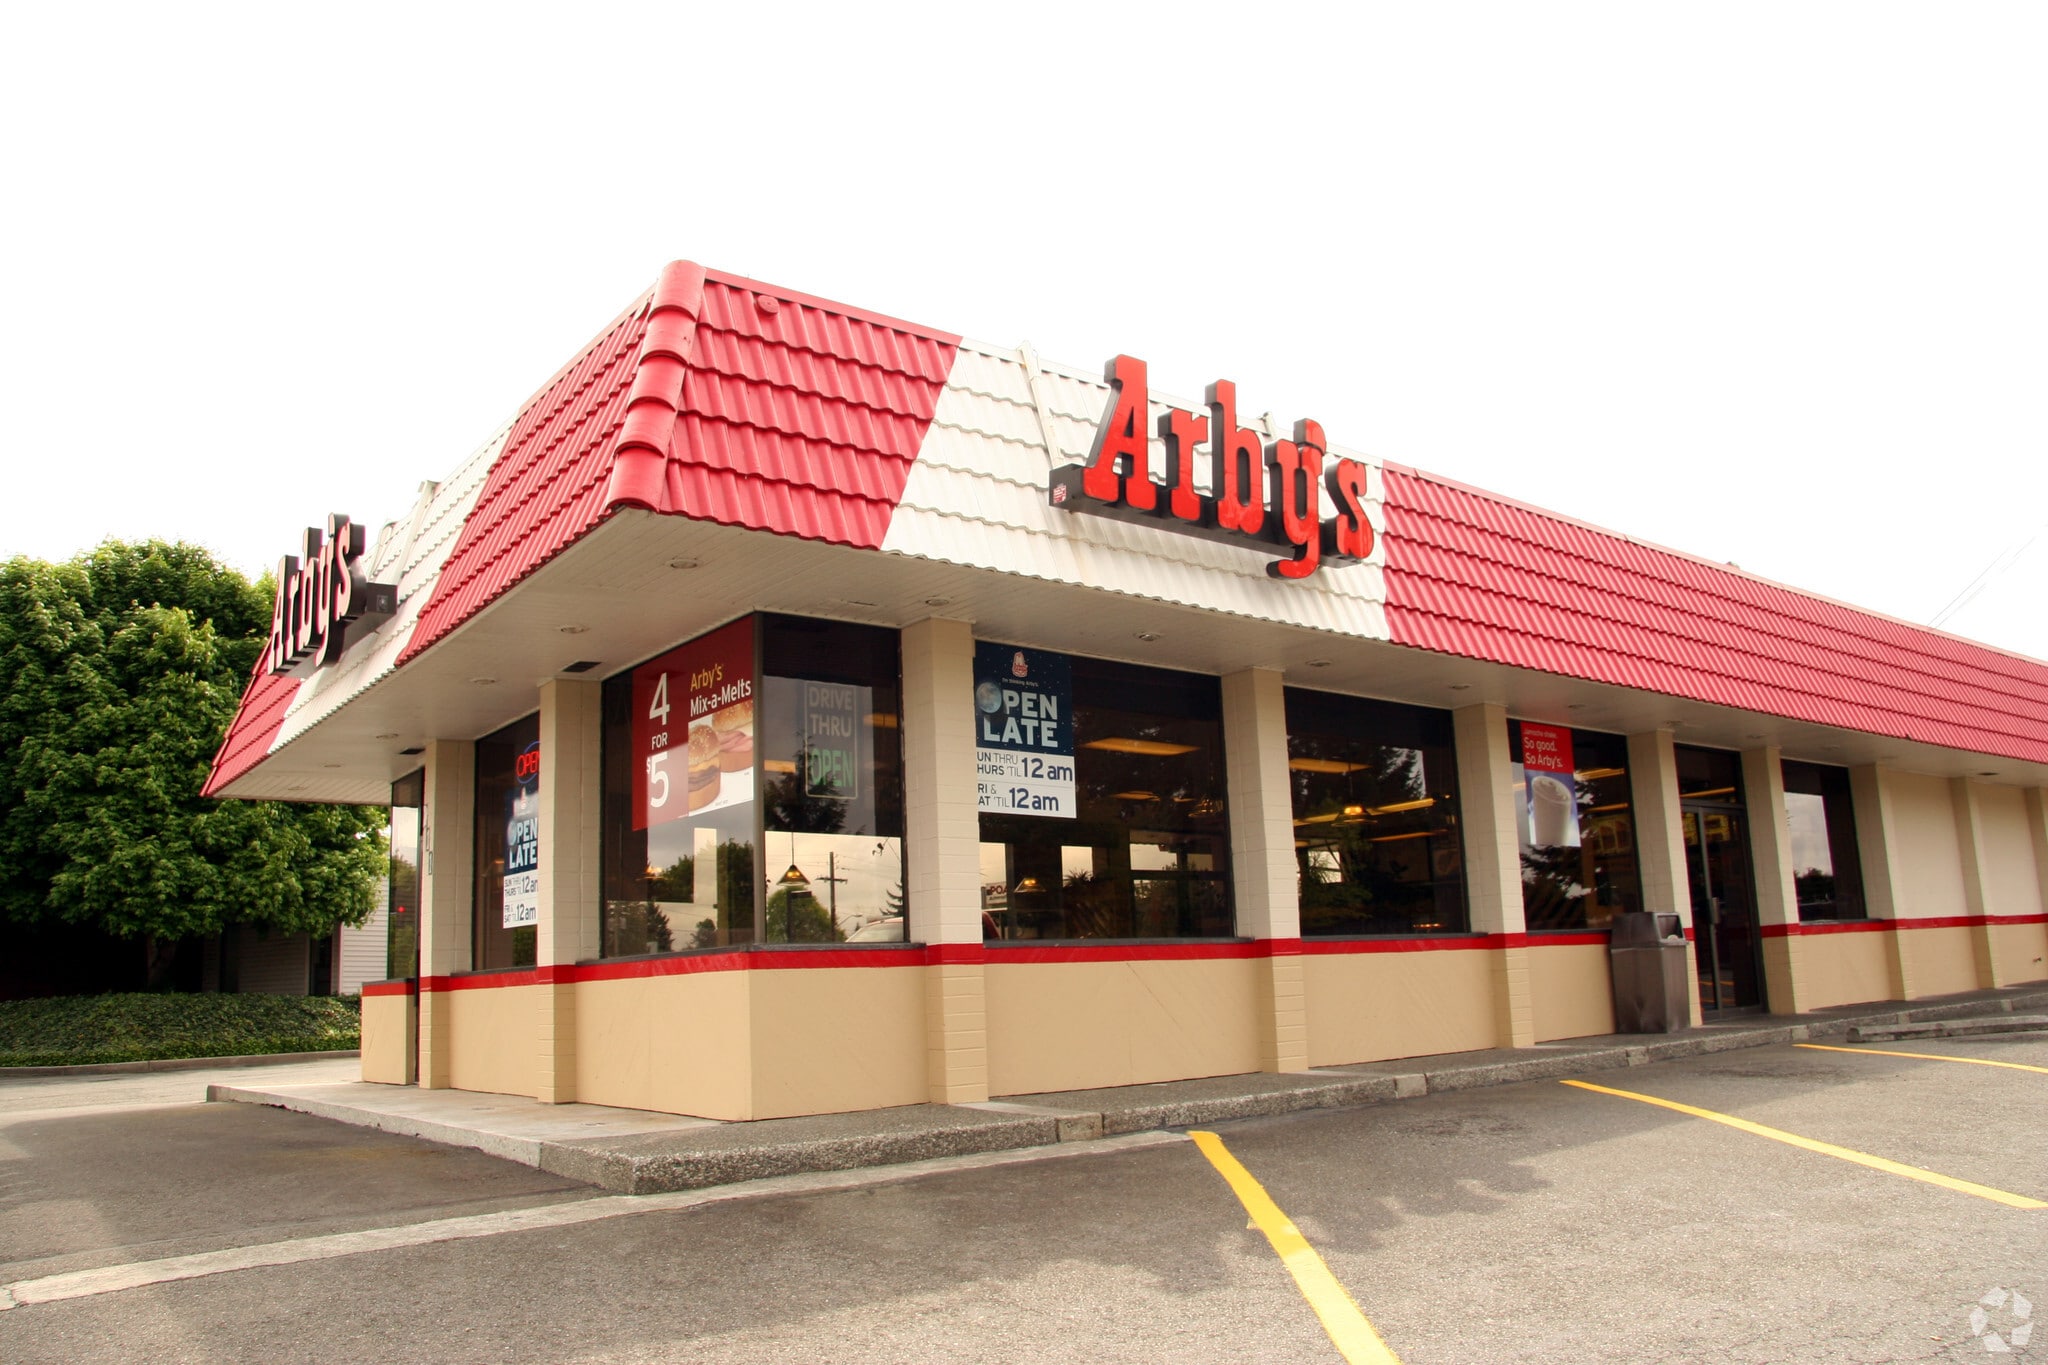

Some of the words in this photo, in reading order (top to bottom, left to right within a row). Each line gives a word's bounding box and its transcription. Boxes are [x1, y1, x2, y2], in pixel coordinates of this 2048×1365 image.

[1083, 354, 1375, 579] Arby's
[267, 512, 354, 675] Arby's
[690, 663, 724, 692] Arby's
[649, 672, 670, 726] 4
[690, 678, 752, 718] Mix-a-Melts
[808, 686, 853, 711] DRIVE
[810, 713, 851, 737] THRU
[983, 717, 1059, 748] LATE
[651, 732, 668, 750] FOR
[1523, 736, 1535, 749] So
[810, 747, 853, 788] OPEN
[977, 752, 991, 762] UN
[993, 753, 1018, 765] THRU
[977, 765, 1004, 776] HURS
[1525, 752, 1537, 765] So
[978, 784, 988, 794] RI
[990, 784, 997, 795] &
[978, 796, 990, 806] AT
[509, 840, 537, 869] LATE
